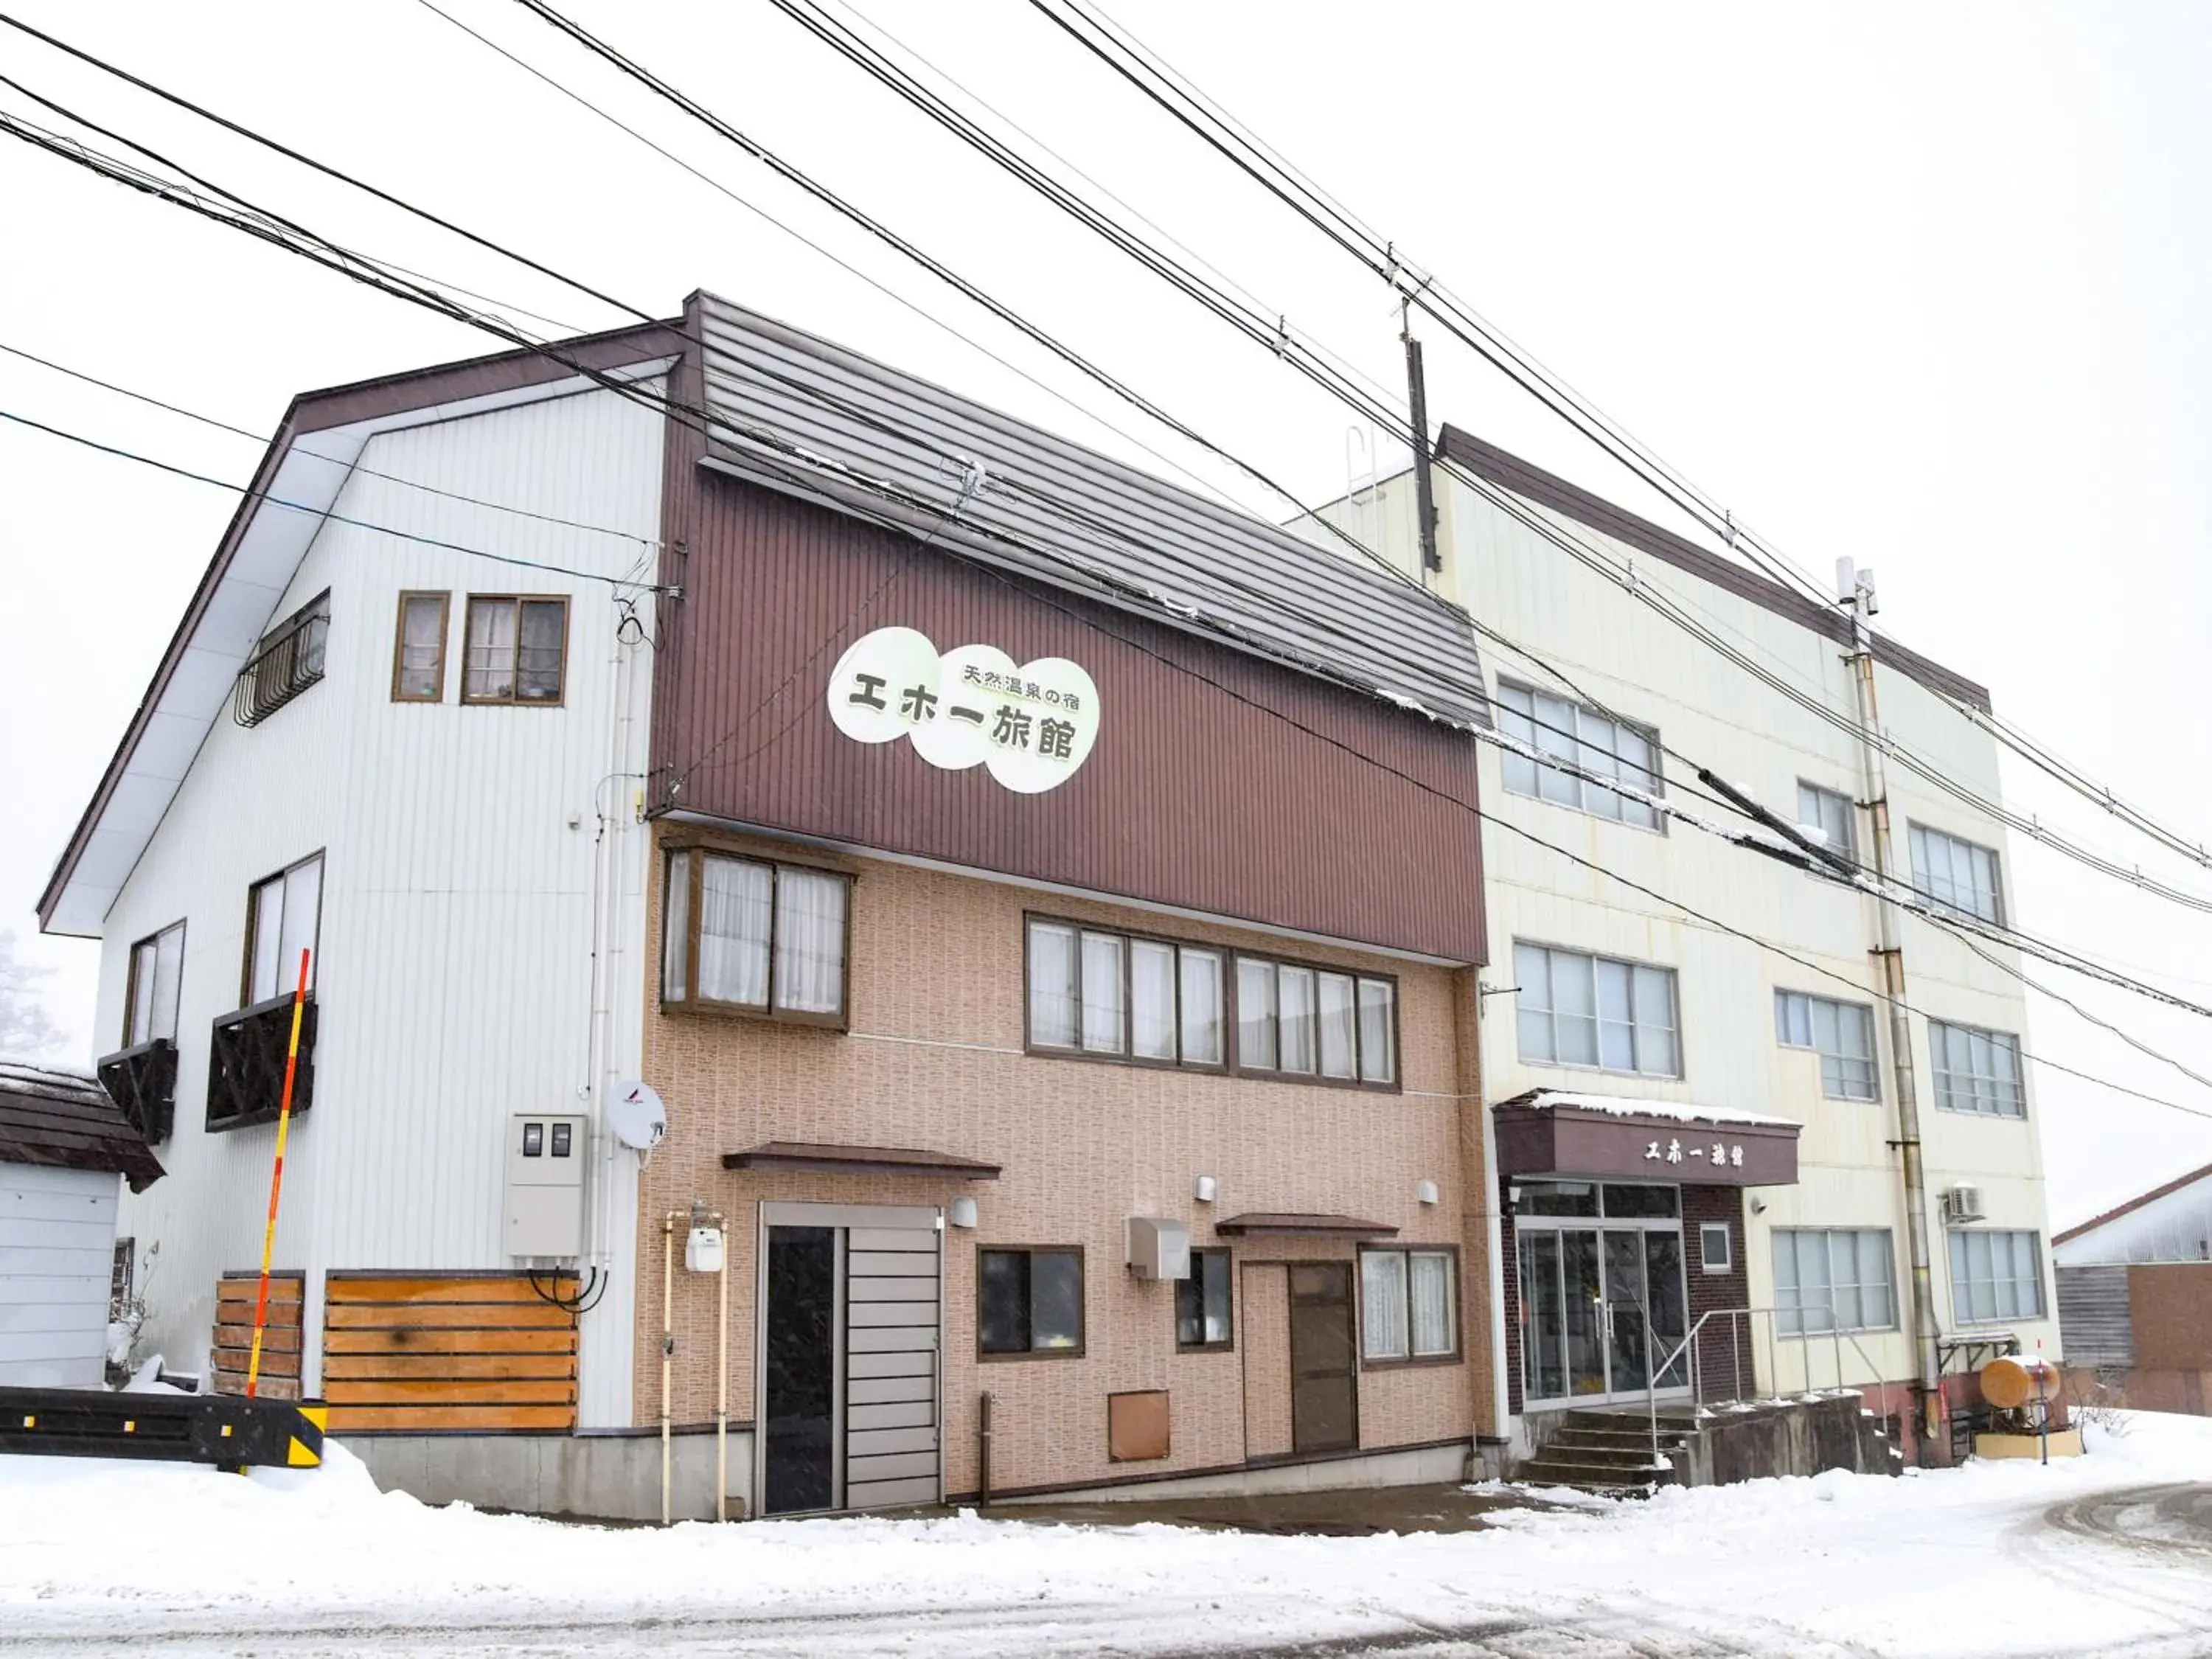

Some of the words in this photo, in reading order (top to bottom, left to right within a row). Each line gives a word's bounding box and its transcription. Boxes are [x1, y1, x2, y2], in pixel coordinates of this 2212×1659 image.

[964, 664, 1080, 711] 天然温泉の宿
